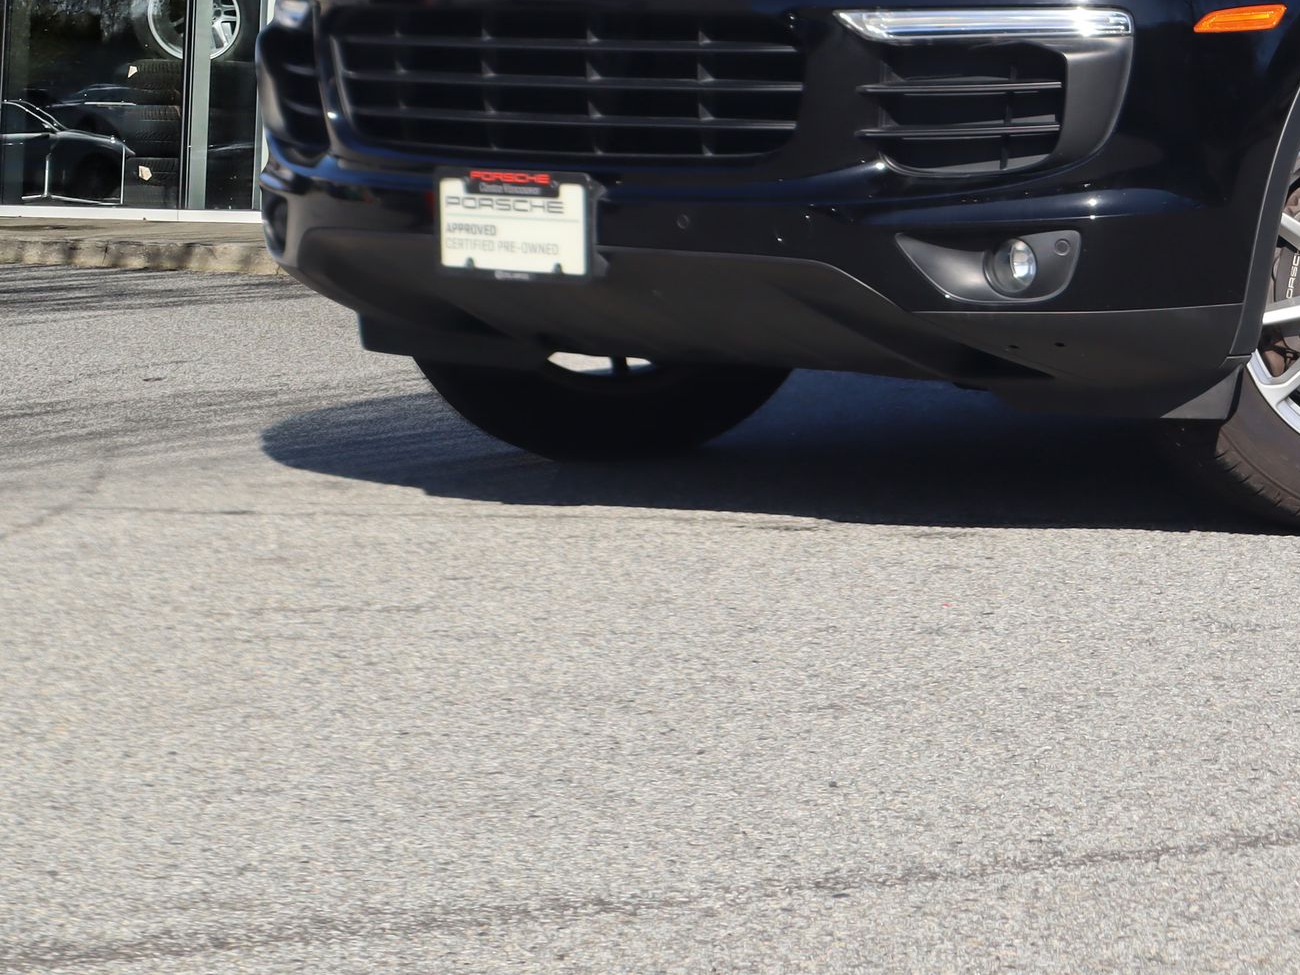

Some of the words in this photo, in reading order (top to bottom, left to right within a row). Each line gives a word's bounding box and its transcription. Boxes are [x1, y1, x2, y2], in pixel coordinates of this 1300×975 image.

[470, 170, 550, 184] PORSCHE
[445, 195, 565, 214] PORSCHE
[446, 222, 497, 236] APPROVED
[446, 237, 495, 252] CERTIFIED
[497, 240, 560, 256] PRE-OWNED
